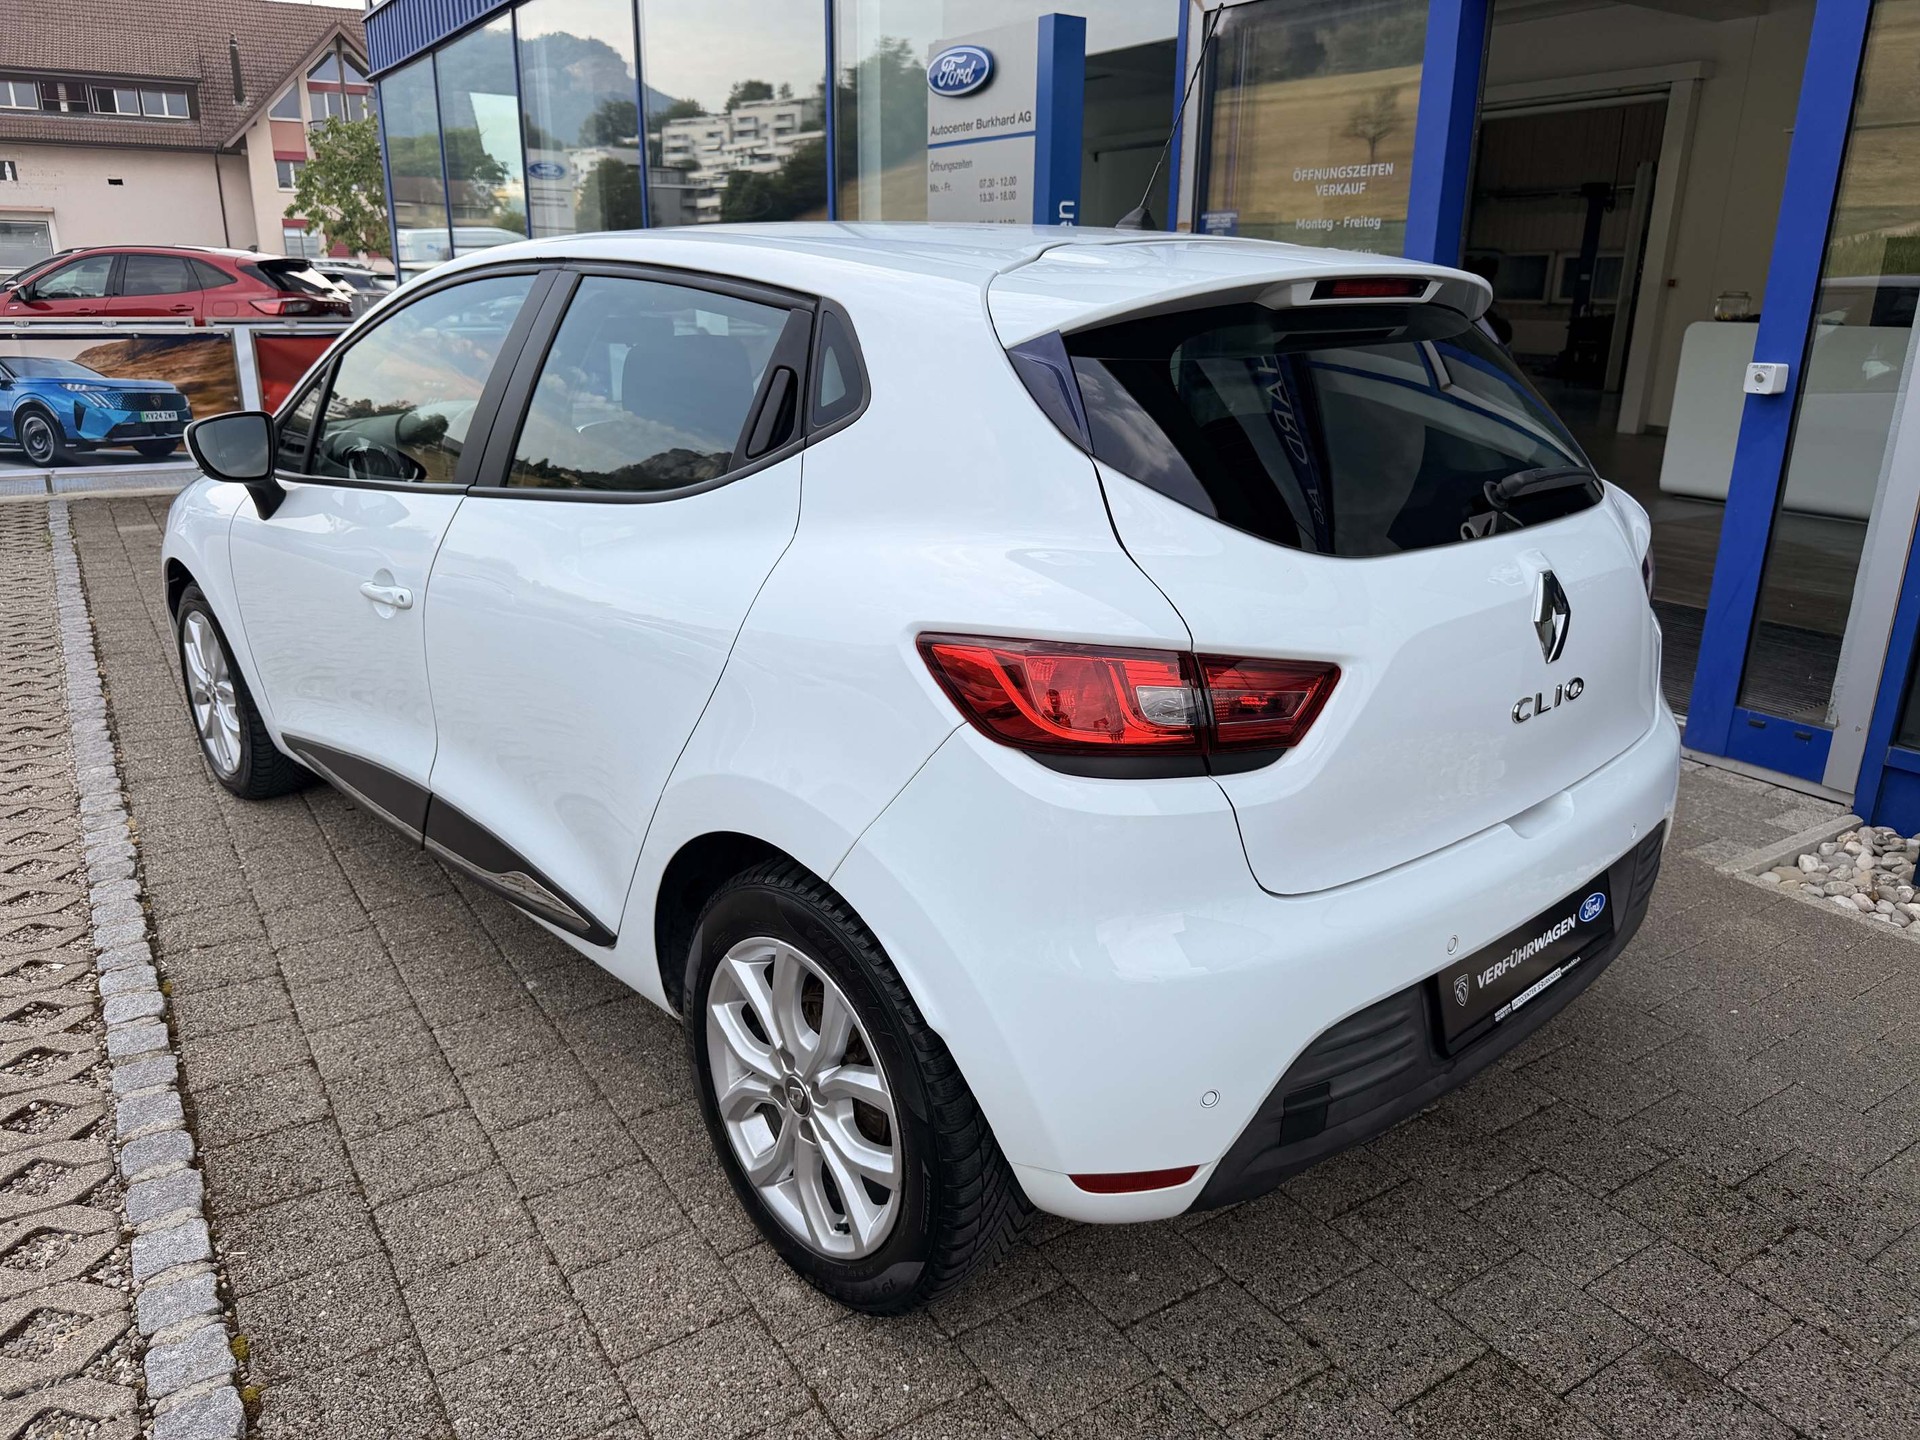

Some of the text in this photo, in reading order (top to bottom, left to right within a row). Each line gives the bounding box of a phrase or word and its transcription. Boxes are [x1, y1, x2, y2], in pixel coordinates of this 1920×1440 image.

[937, 54, 976, 88] Ford
[930, 111, 1032, 137] Autocenter Burkhard AG
[930, 159, 973, 173] Öffnungszeiten
[1292, 162, 1394, 182] ÖFFNUNGSZEITEN
[1315, 182, 1367, 197] VERKAUF
[1295, 218, 1334, 231] Montag
[1343, 216, 1381, 230] Freitag
[1511, 677, 1584, 724] CLIO
[1584, 897, 1601, 919] Ford
[1477, 913, 1576, 989] VERFÜHRWAGEN
